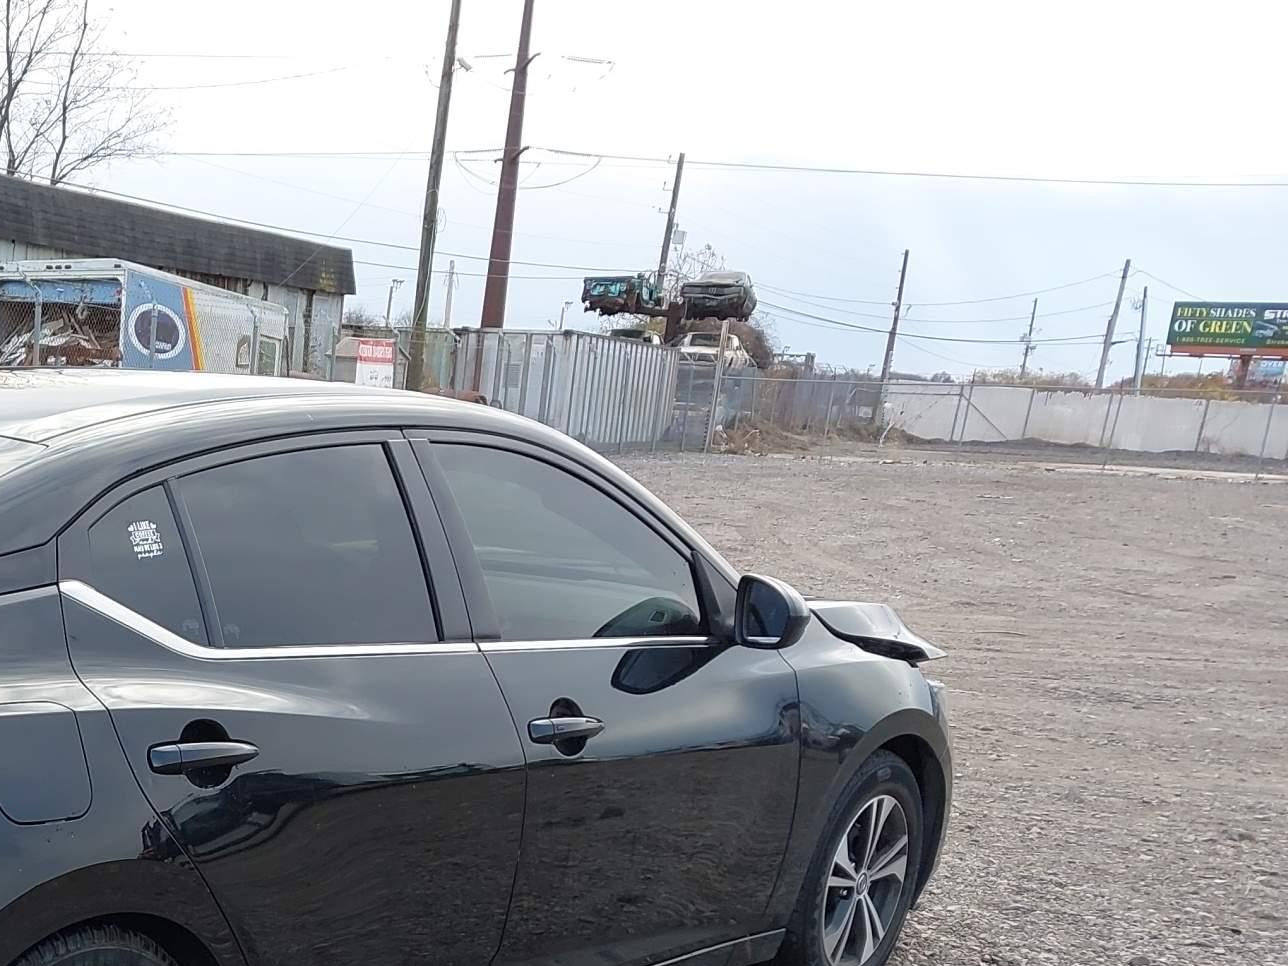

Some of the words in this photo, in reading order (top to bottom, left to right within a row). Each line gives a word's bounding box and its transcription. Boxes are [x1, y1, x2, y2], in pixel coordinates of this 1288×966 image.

[1176, 307, 1209, 317] FIFTY
[1209, 307, 1256, 318] SHADES
[1174, 319, 1197, 332] OF
[1199, 320, 1252, 334] GREEN
